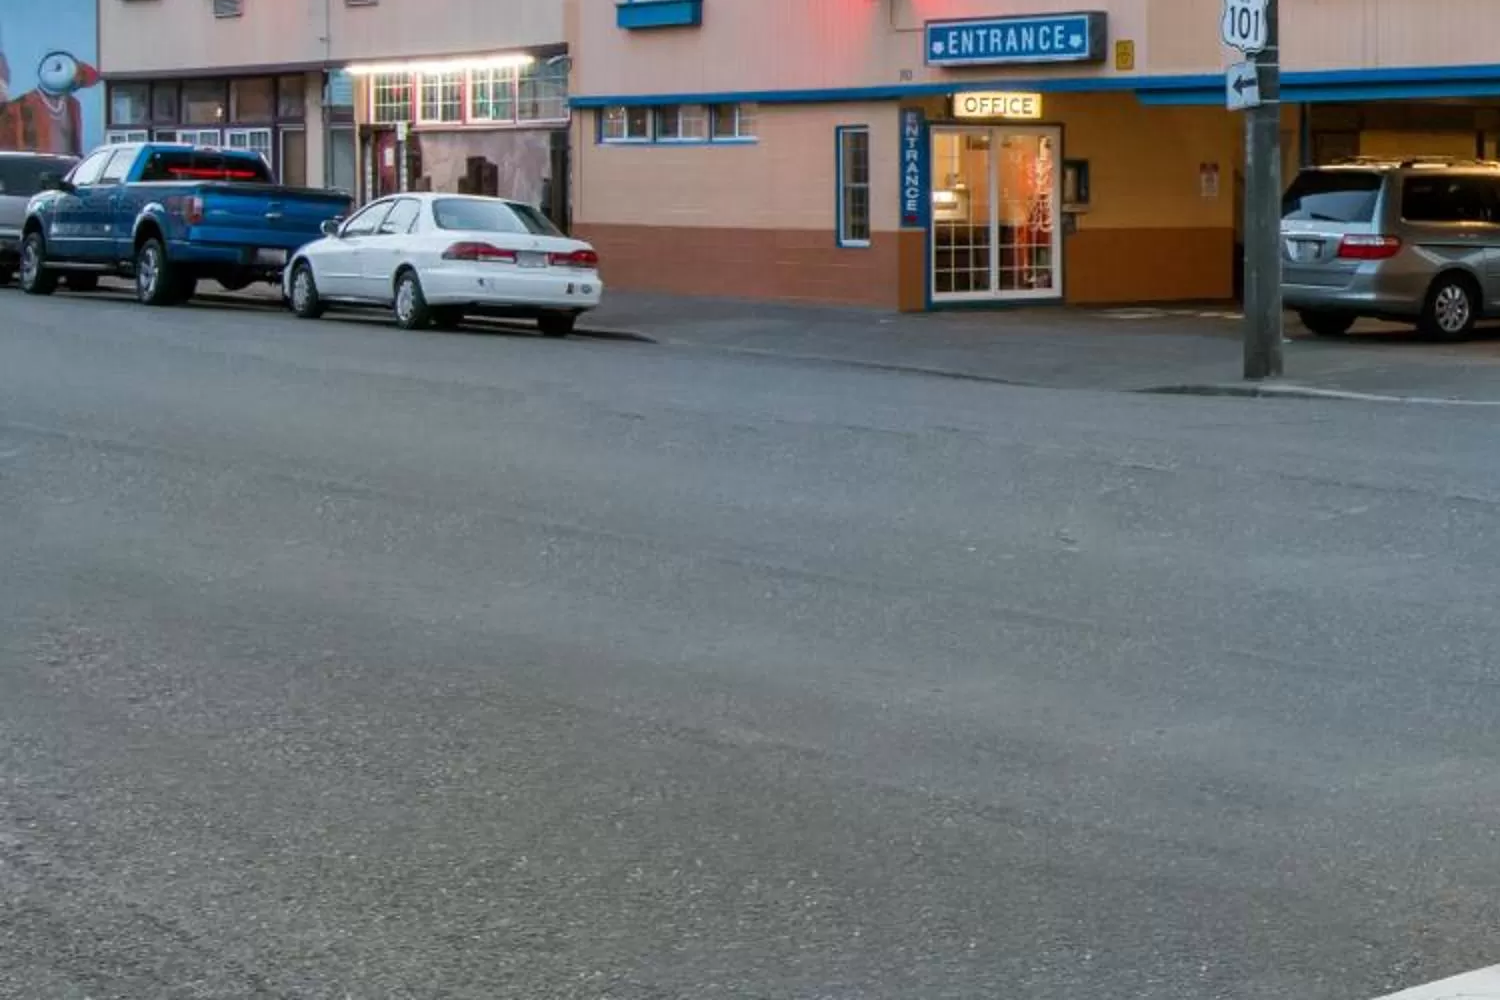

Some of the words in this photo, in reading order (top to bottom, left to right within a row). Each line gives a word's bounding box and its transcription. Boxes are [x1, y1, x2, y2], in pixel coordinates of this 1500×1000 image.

[948, 24, 1065, 55] ENTRANCE
[1229, 5, 1260, 42] 101
[963, 96, 1034, 115] OFFICE
[904, 110, 920, 212] ENTRANCE
